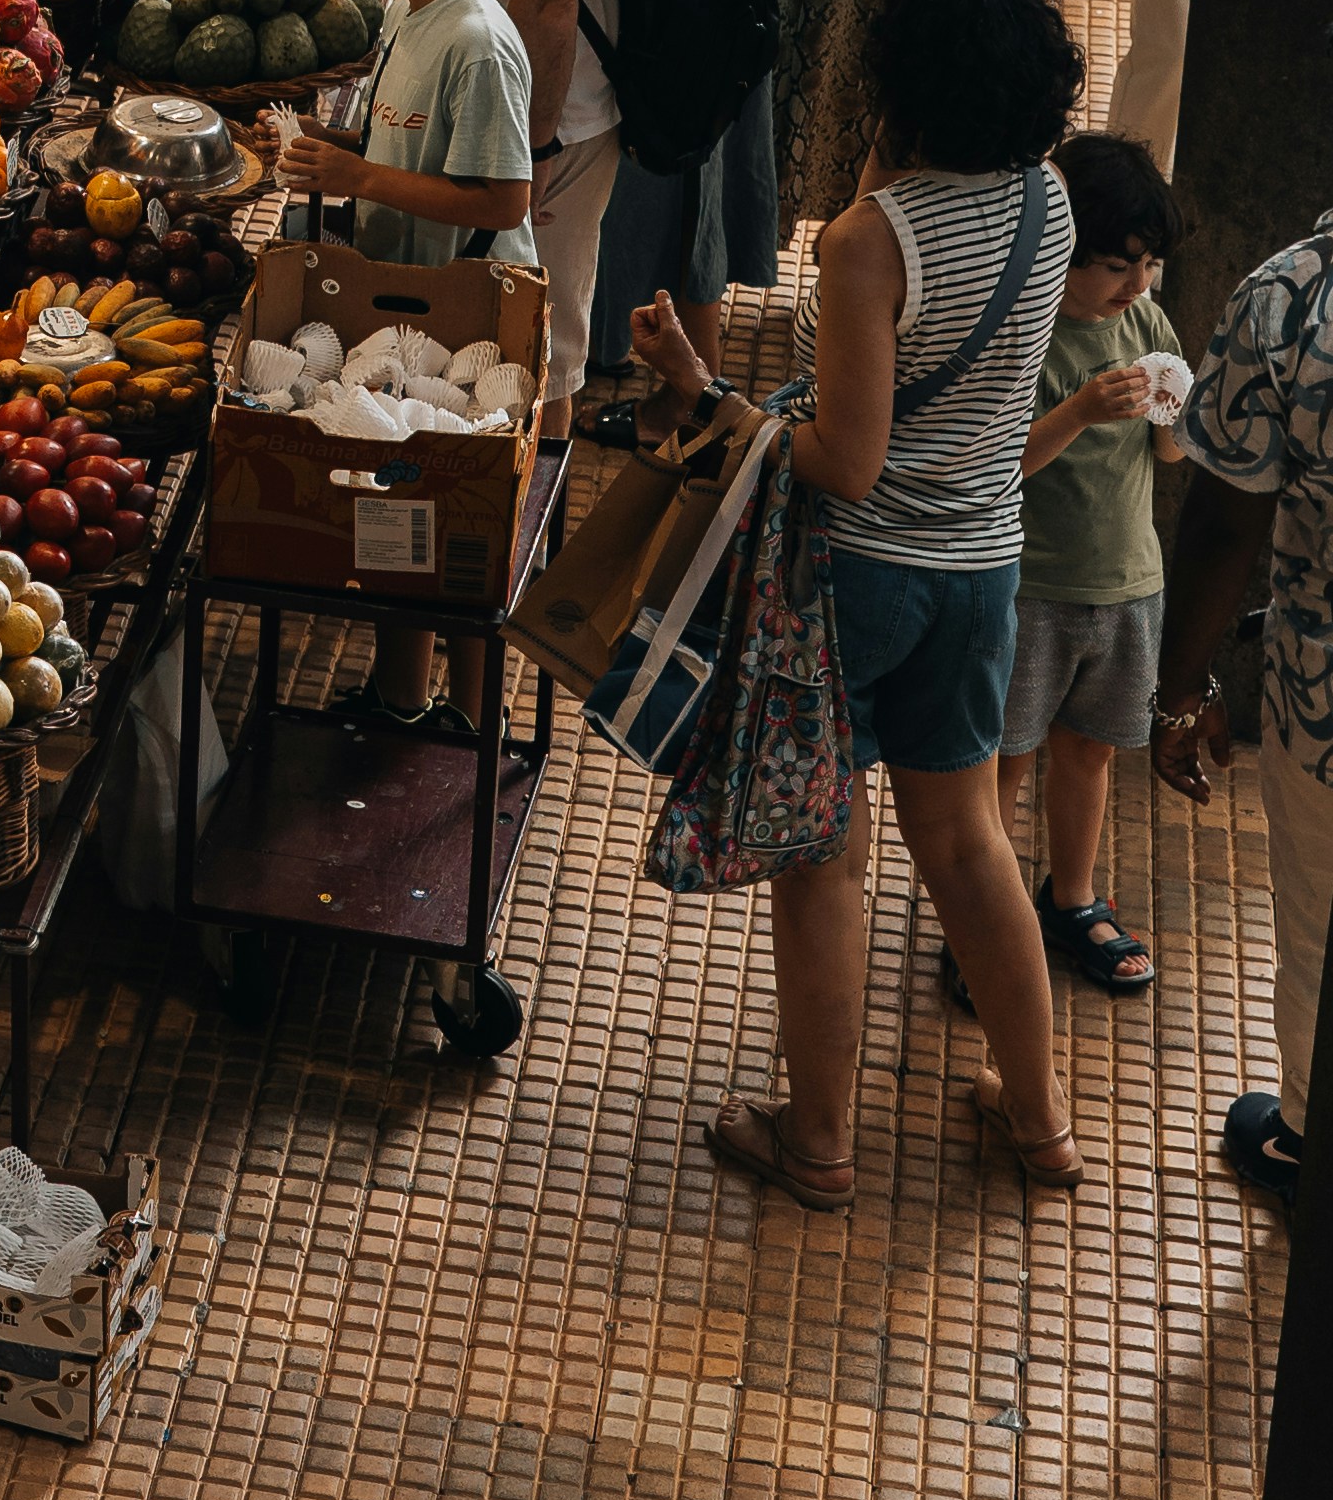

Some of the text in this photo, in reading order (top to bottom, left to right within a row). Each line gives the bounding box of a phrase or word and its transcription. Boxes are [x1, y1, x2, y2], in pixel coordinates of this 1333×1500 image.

[268, 434, 358, 462] Banana
[382, 446, 478, 473] Madeira
[357, 499, 388, 509] GESBA
